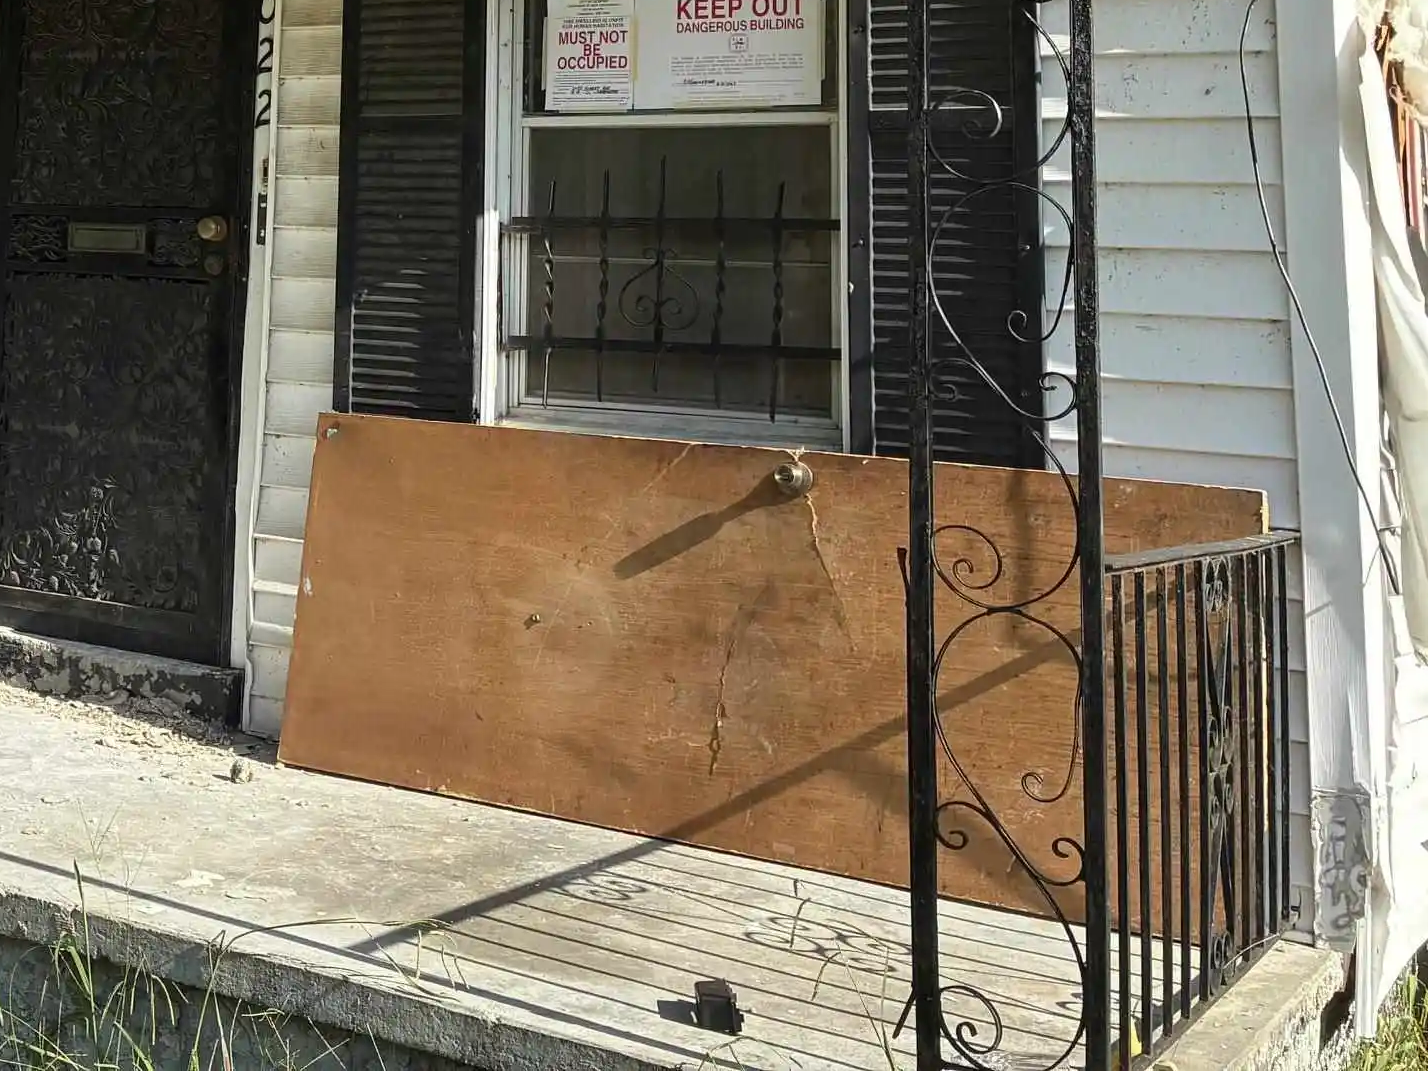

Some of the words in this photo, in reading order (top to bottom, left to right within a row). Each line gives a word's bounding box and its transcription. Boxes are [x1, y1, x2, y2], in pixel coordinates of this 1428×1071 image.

[676, 20, 747, 33] DANGEROUS
[750, 18, 804, 31] BUILDING
[559, 31, 595, 45] MUST
[599, 30, 628, 43] NOT
[583, 43, 601, 56] BE
[557, 56, 628, 69] OCCUPIED
